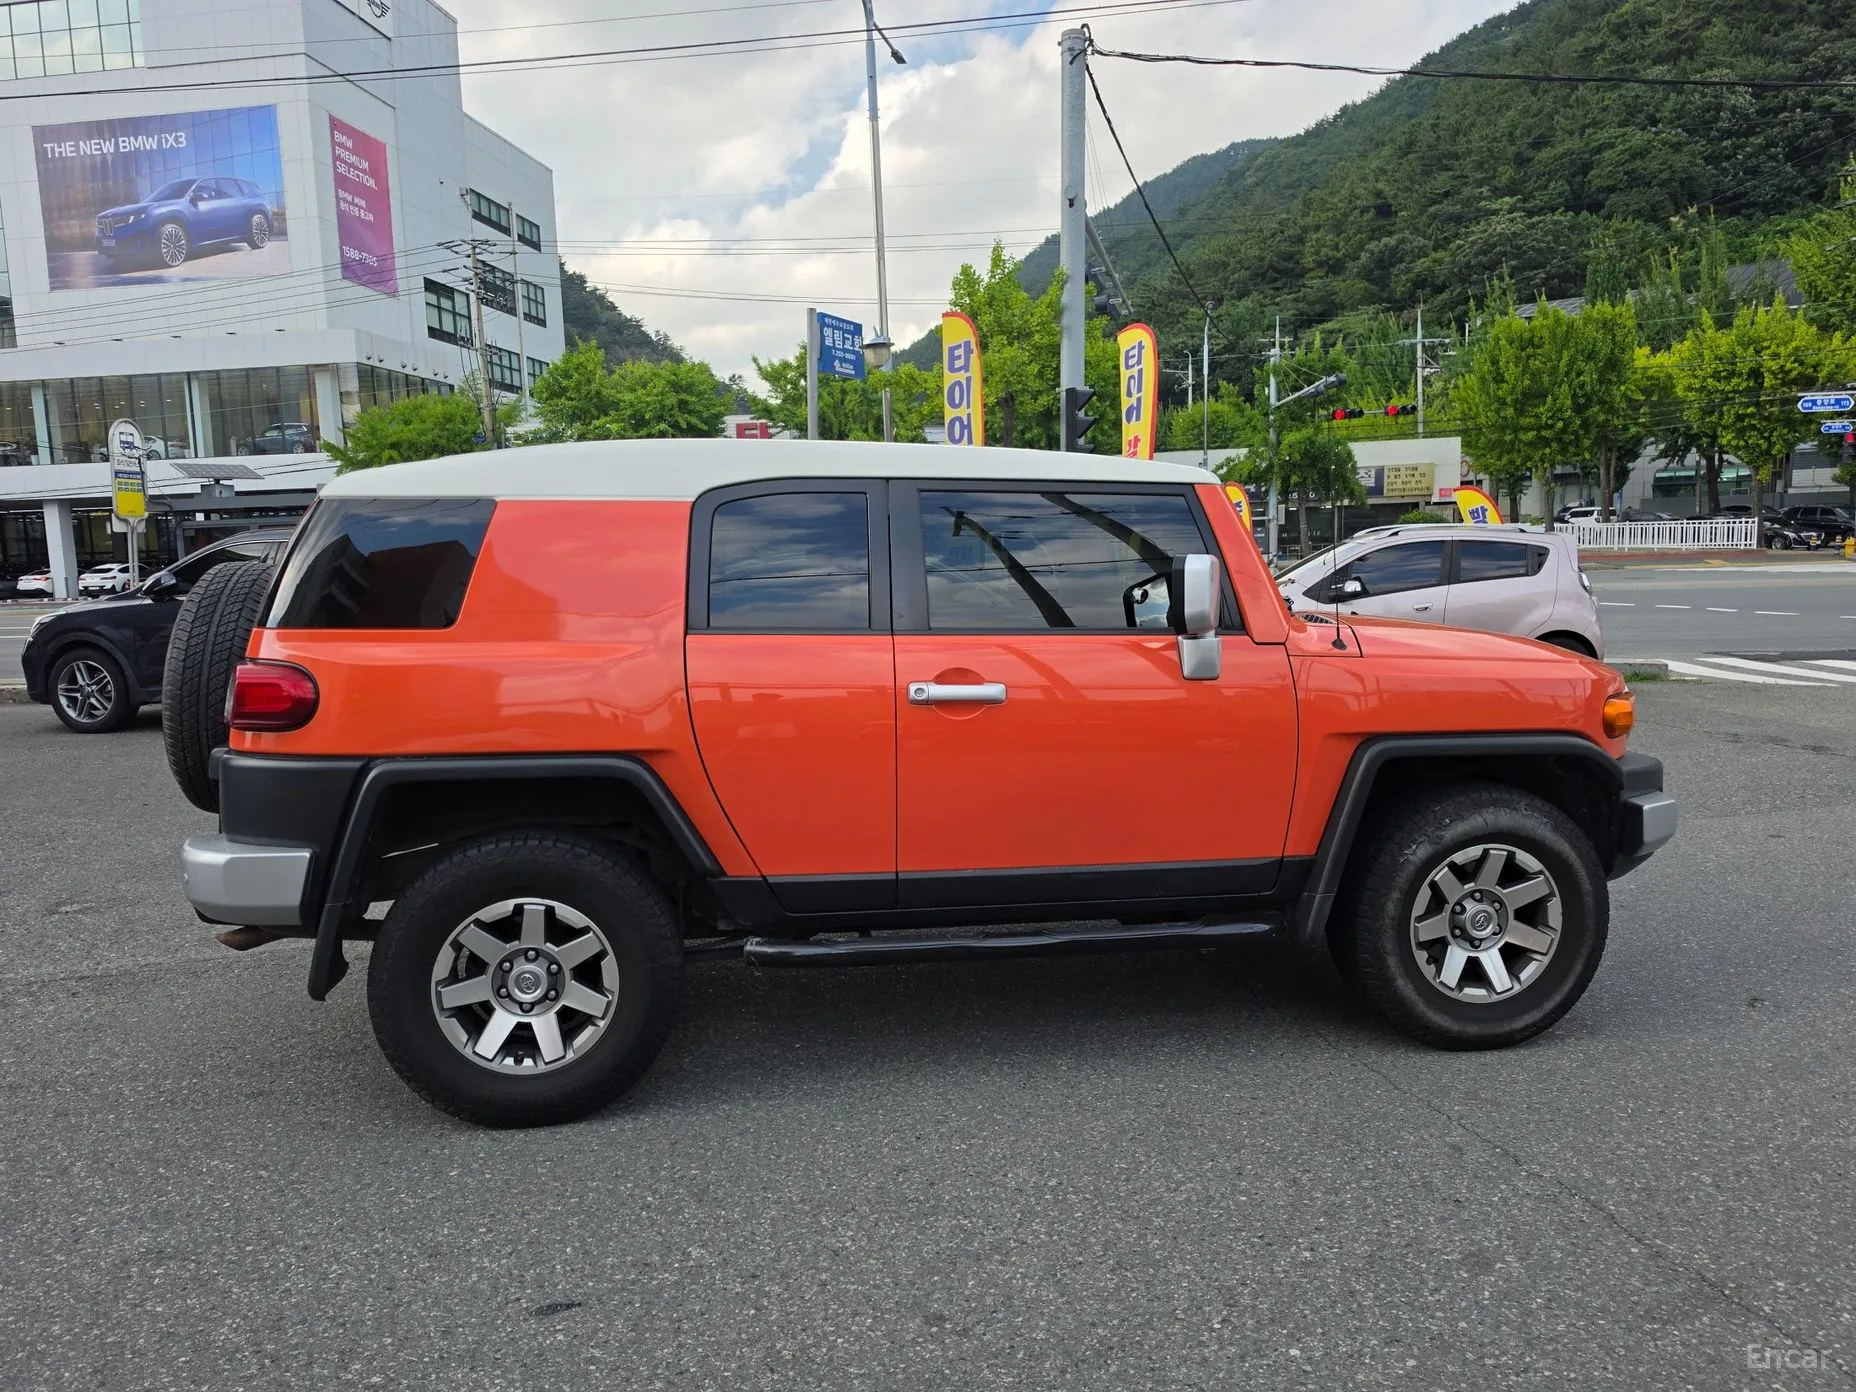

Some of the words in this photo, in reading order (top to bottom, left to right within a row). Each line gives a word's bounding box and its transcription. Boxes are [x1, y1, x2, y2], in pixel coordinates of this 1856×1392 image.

[43, 141, 77, 158] THE
[79, 138, 115, 156] NEW
[118, 135, 158, 152] BMW
[161, 132, 187, 149] iX3
[334, 130, 353, 149] BMW
[335, 145, 369, 171] PREMIUM
[336, 161, 378, 191] SELECTION.
[338, 189, 353, 203] BMW
[823, 327, 863, 355] 엘림교회
[947, 340, 974, 446] 타이어
